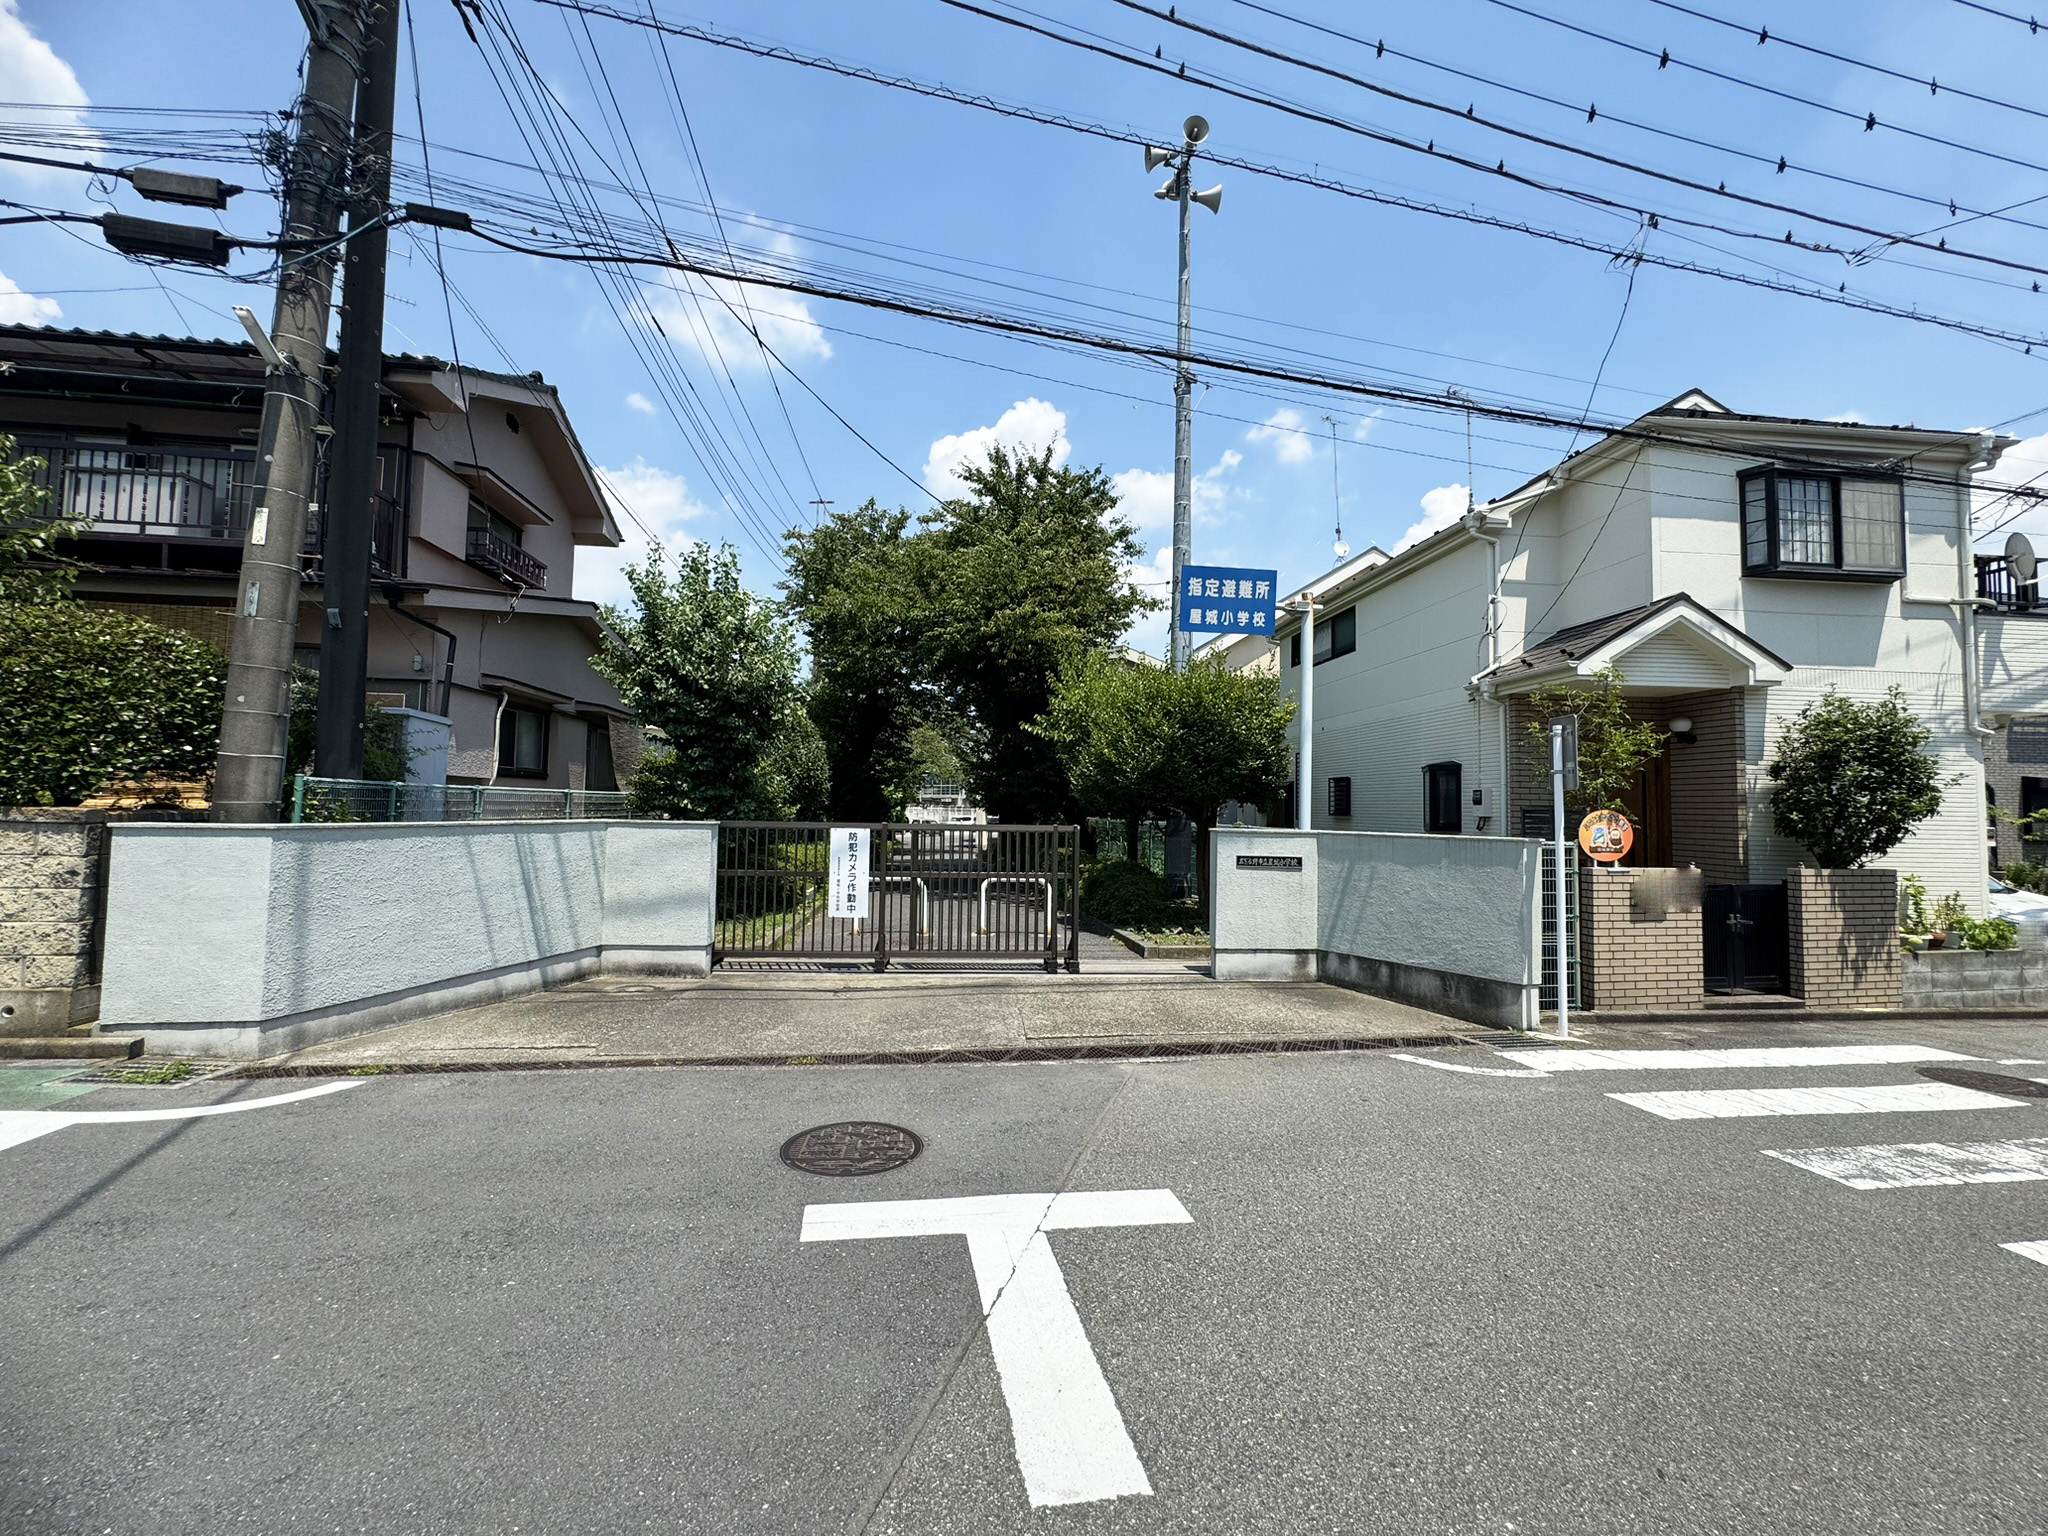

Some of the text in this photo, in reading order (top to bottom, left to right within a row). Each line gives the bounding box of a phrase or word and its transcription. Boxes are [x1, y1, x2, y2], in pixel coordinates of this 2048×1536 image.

[1188, 577, 1270, 600] 指定避難所
[1189, 608, 1266, 627] 屋城小学校
[846, 832, 858, 914] 防犯カメラ作動中
